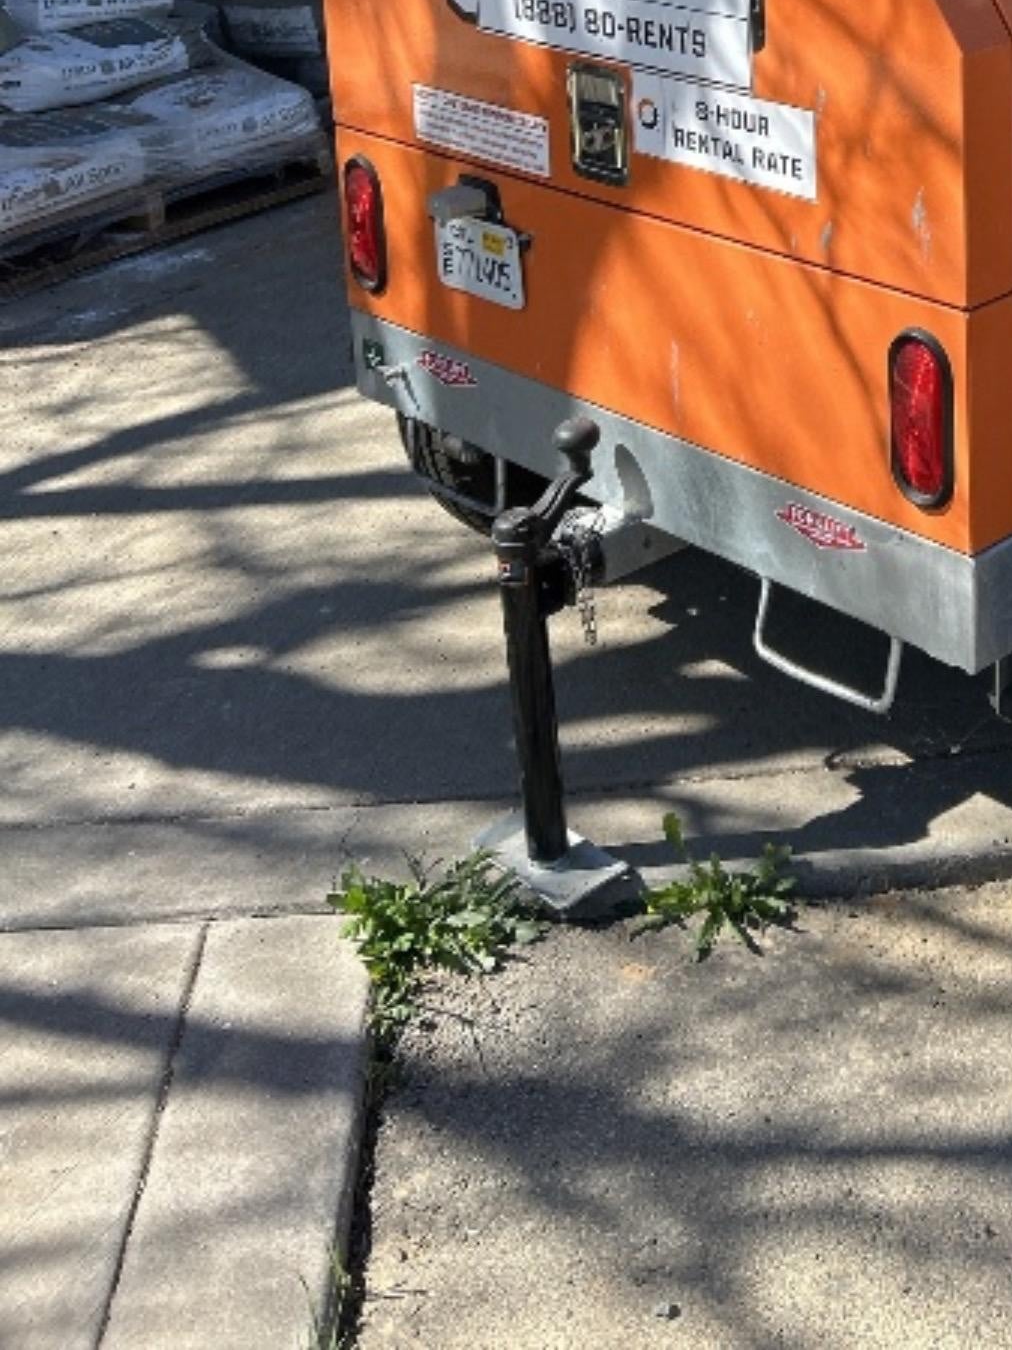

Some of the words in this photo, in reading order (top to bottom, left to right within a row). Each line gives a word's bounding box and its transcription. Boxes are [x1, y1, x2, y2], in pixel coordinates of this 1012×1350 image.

[584, 9, 707, 58] 80-RENTS
[695, 100, 770, 138] 8-HOUR
[673, 123, 745, 166] RENTAL
[752, 146, 804, 181] RATE
